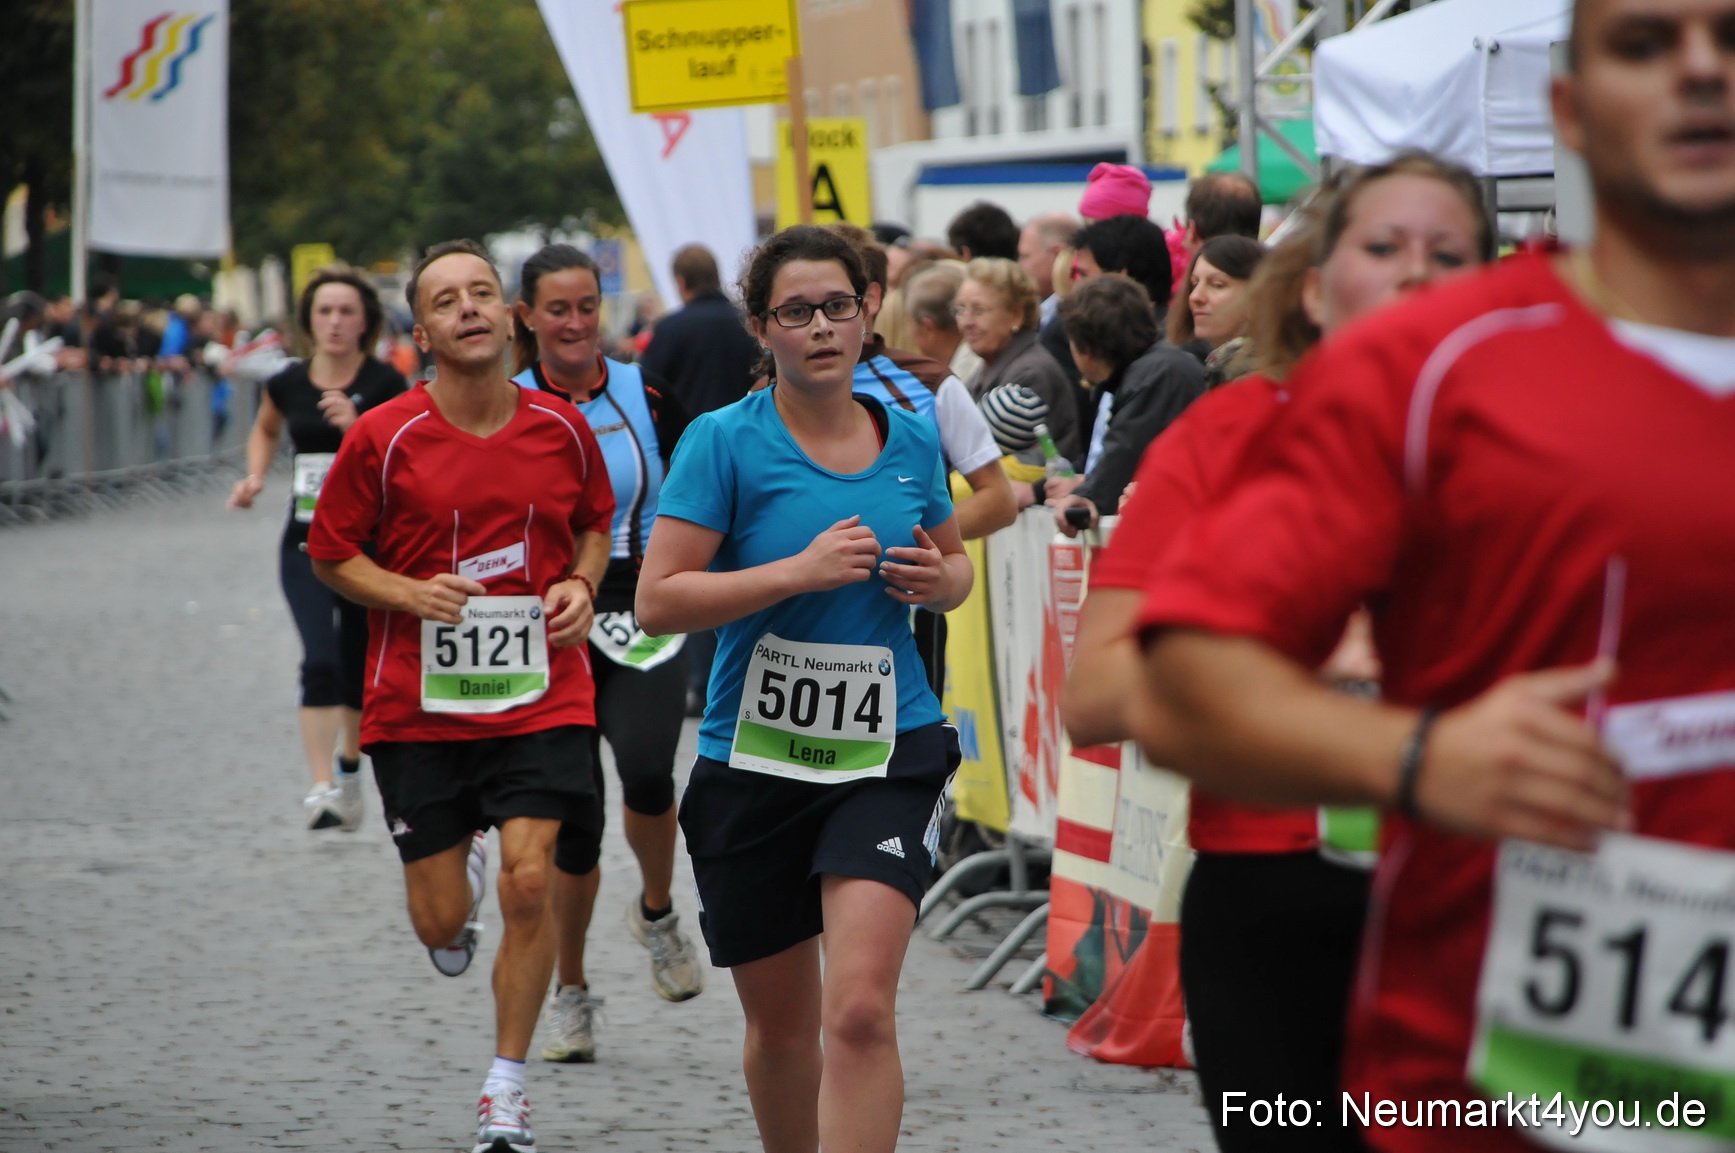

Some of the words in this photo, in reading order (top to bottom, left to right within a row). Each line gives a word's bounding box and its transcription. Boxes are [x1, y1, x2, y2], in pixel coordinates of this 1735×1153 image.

[635, 25, 785, 51] Schnupper-
[688, 54, 737, 79] lauf
[811, 163, 846, 220] A
[477, 555, 507, 573] DEHN
[468, 608, 525, 619] Neumarkt
[435, 625, 530, 668] 5121
[755, 644, 800, 668] PARTL
[804, 657, 873, 673] Neumarkt
[460, 679, 511, 695] Daniel
[757, 669, 883, 734] 5014
[788, 739, 837, 765] Lena
[876, 843, 905, 858] adidas
[1523, 907, 1729, 1043] 514
